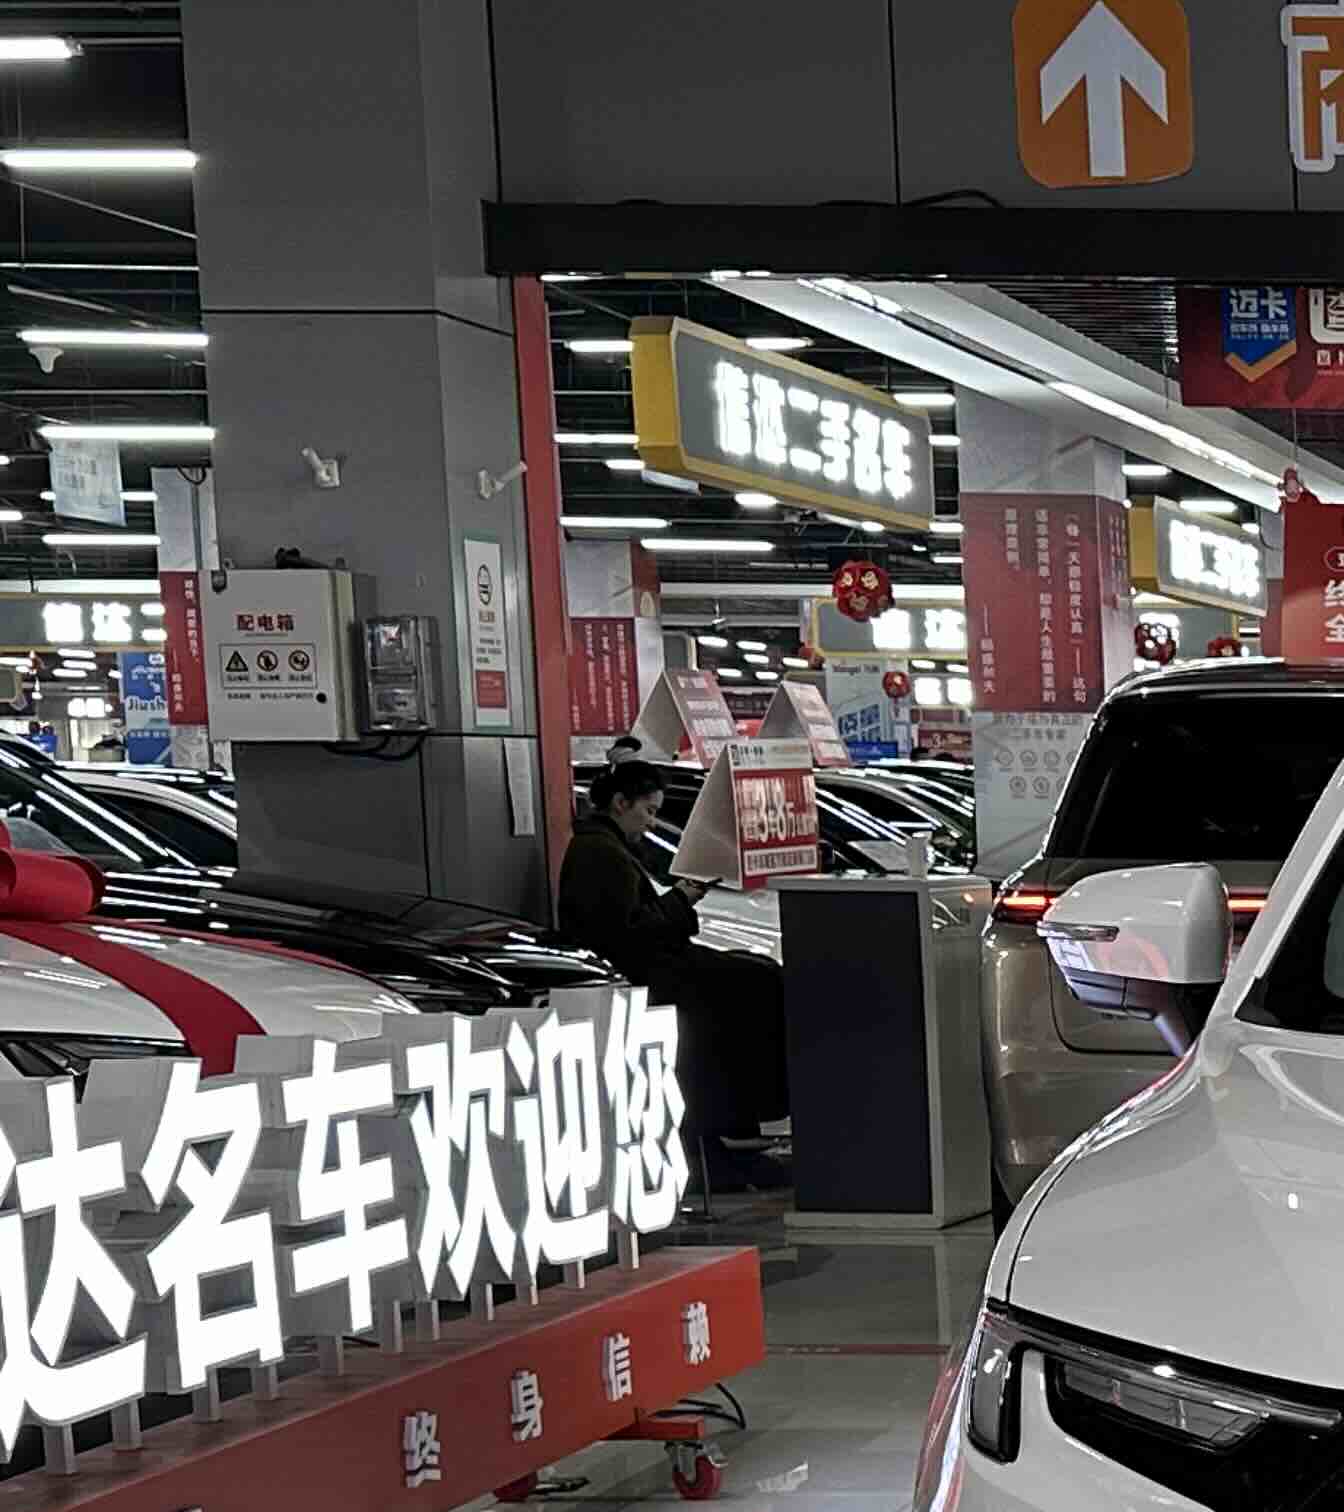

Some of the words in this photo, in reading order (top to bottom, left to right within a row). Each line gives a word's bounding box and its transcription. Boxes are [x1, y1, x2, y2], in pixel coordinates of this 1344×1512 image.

[1229, 287, 1288, 320] 迈卡
[236, 614, 295, 632] 配电箱
